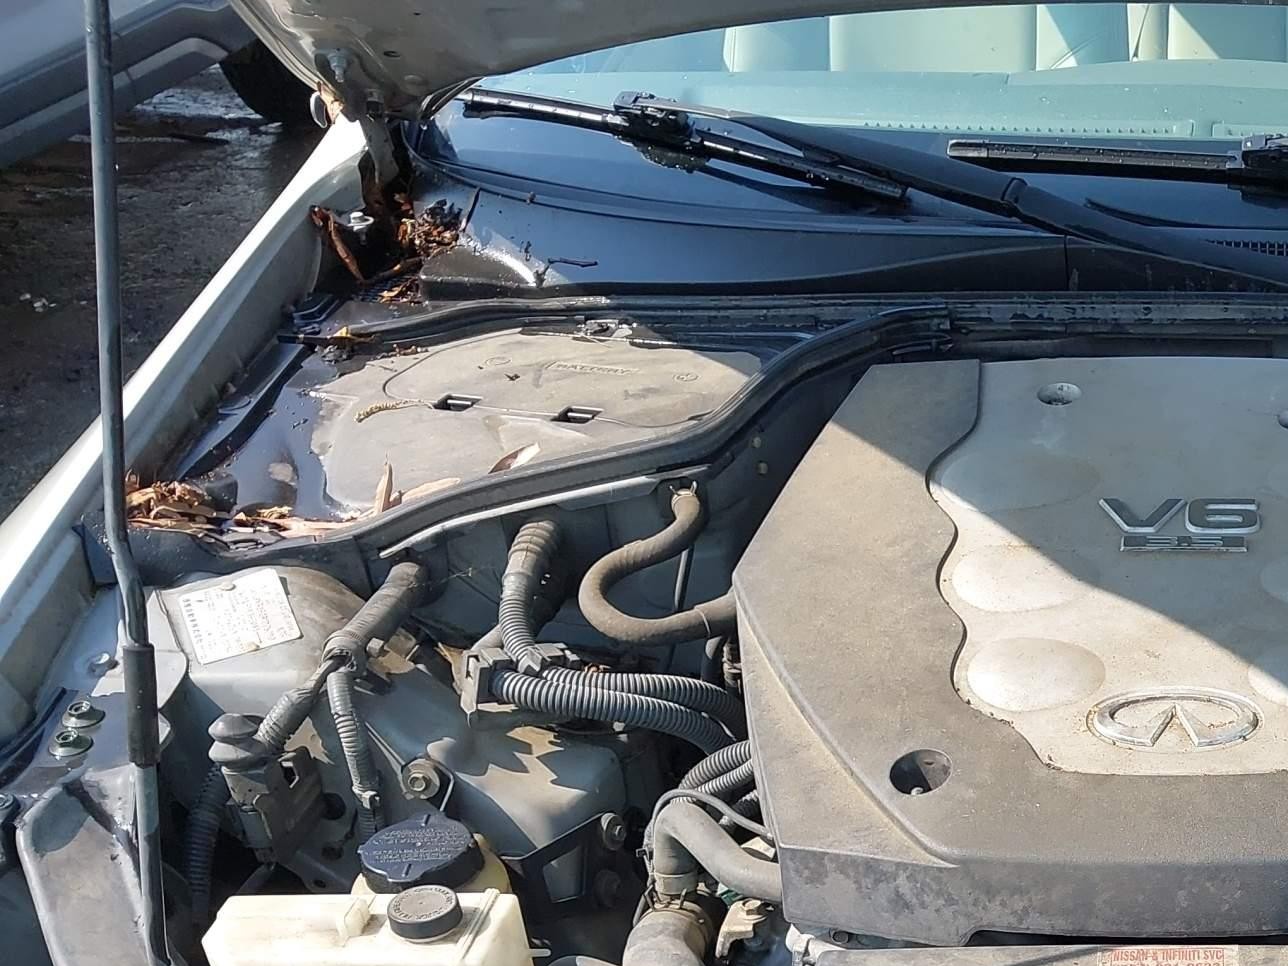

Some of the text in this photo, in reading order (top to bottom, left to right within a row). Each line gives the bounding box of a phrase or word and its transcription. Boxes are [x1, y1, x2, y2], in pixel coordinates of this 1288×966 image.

[1099, 498, 1260, 534] V6
[1145, 536, 1224, 547] 3.5
[1113, 949, 1147, 962] NISSAN
[1162, 949, 1200, 961] INFINITI
[1203, 949, 1223, 961] SVC
